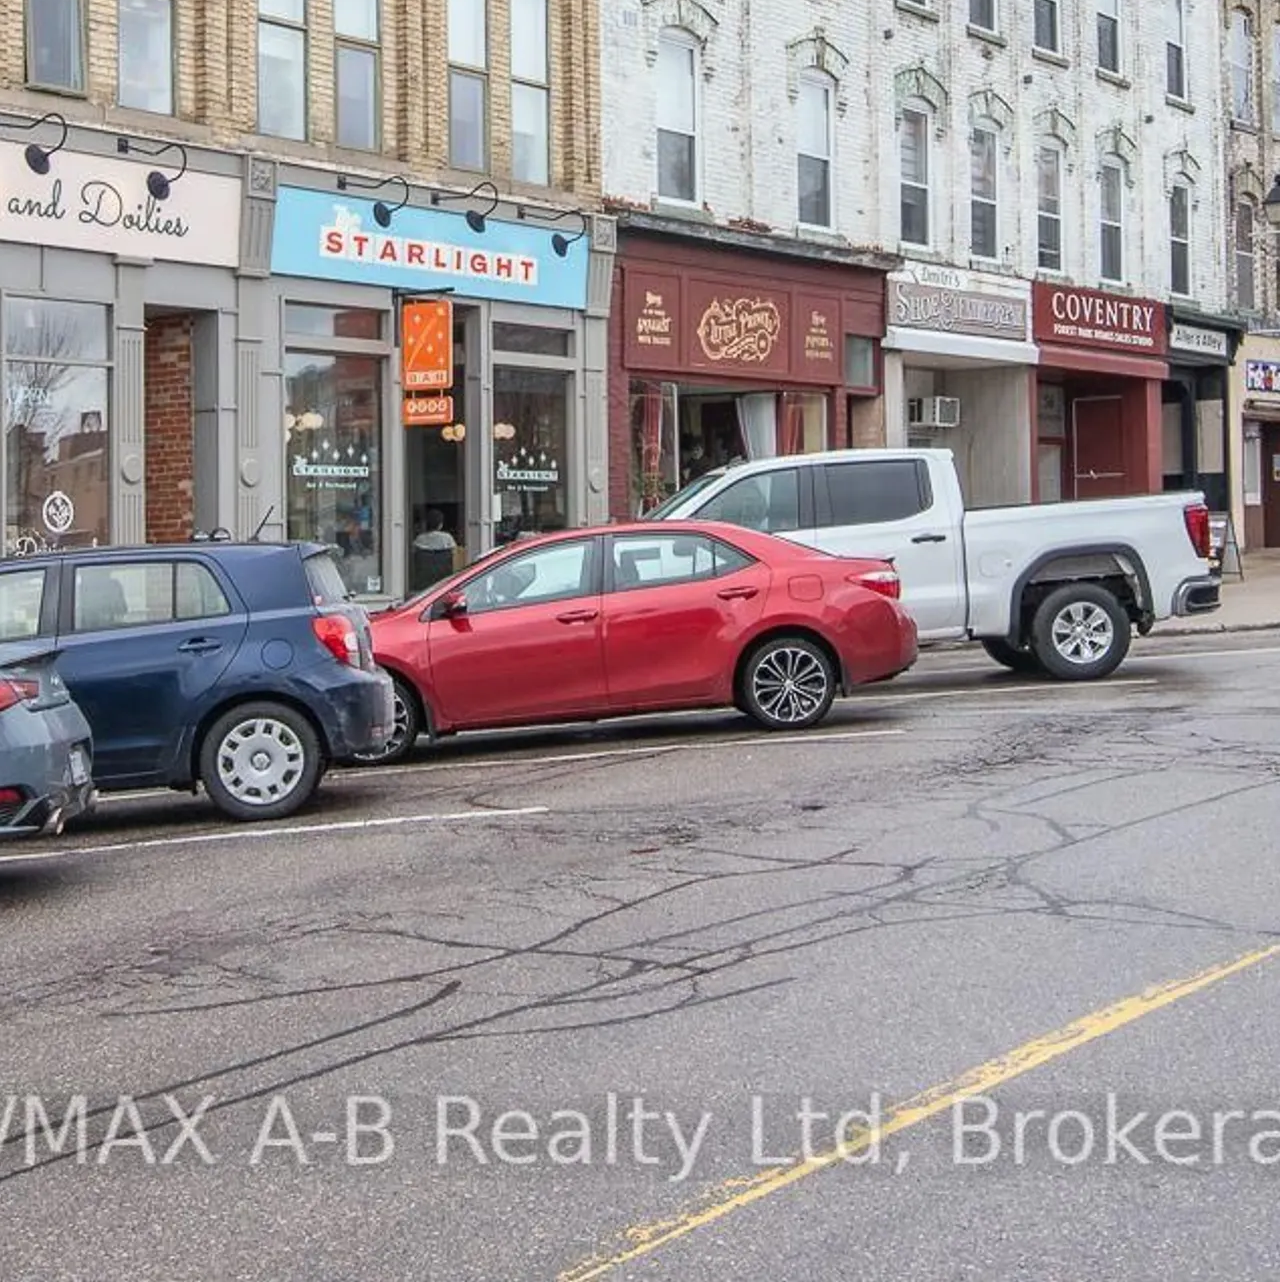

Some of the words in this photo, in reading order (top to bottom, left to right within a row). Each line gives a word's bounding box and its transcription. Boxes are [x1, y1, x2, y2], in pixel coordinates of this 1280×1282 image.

[8, 178, 66, 220] and
[78, 181, 190, 237] Doilies
[325, 231, 535, 281] STARLIGHT
[1052, 292, 1154, 332] COVENTRY
